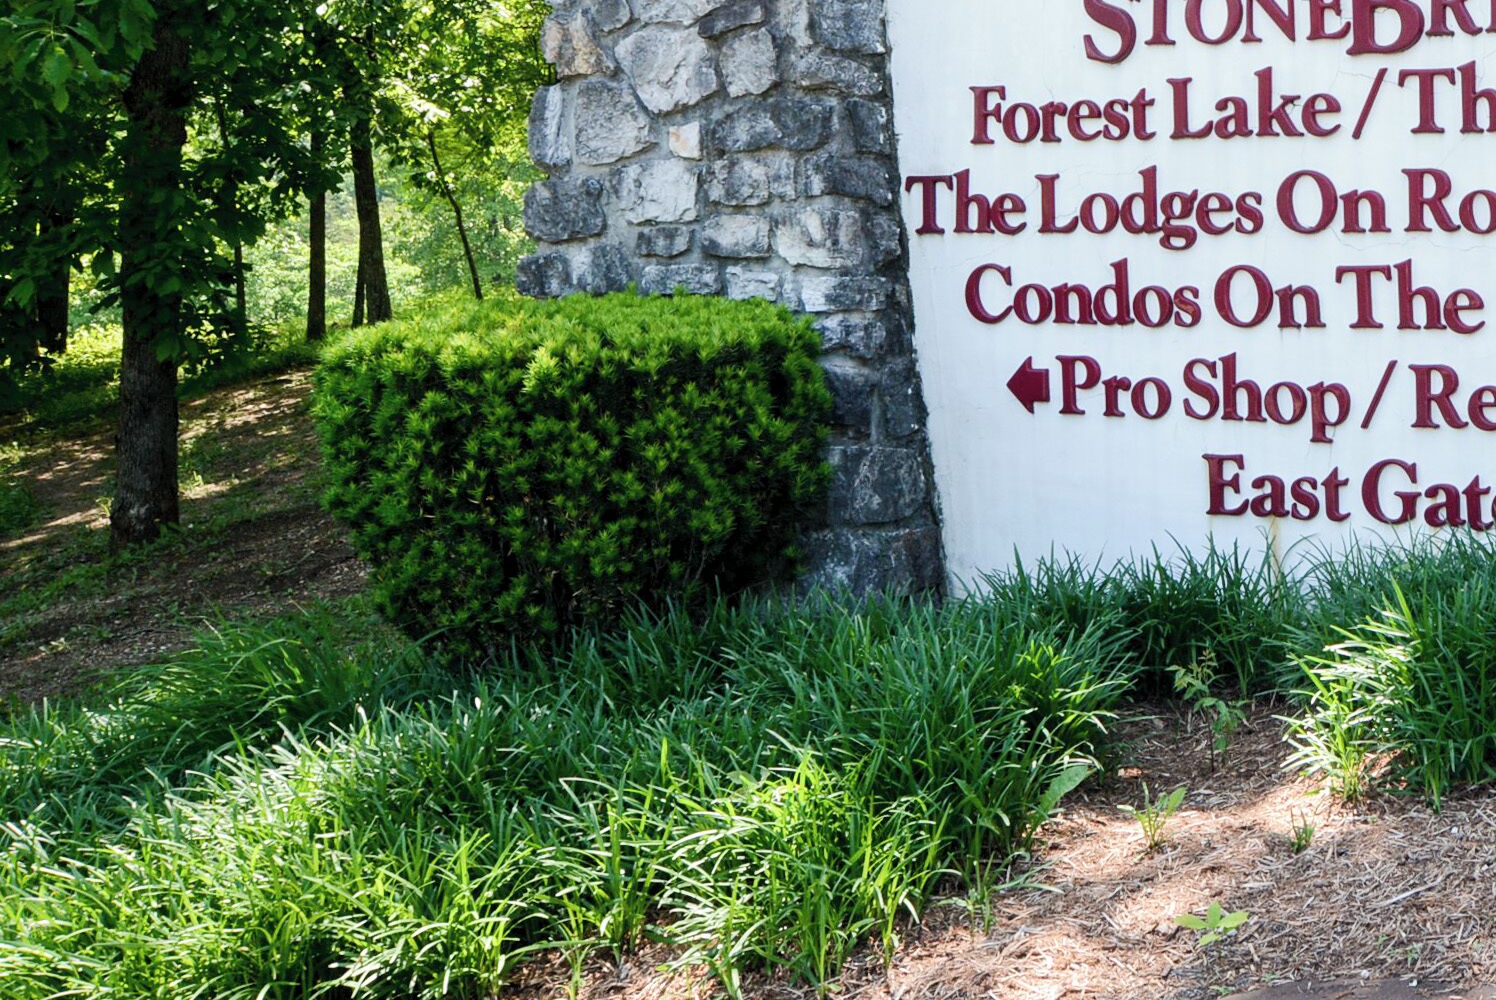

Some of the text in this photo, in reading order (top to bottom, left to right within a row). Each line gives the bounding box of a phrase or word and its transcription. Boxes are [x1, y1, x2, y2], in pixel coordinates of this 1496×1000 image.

[969, 83, 1155, 145] Forest
[1167, 66, 1341, 140] Lake
[1352, 66, 1388, 140] /
[905, 168, 1026, 235] The
[1035, 165, 1263, 251] Lodges
[1276, 169, 1391, 235] On
[964, 258, 1202, 327] Condos
[1213, 264, 1326, 330] On
[1335, 258, 1485, 335] The
[1055, 354, 1172, 420] Pro
[1182, 352, 1351, 444] Shop
[1360, 359, 1397, 430] /
[1202, 453, 1350, 522] East
